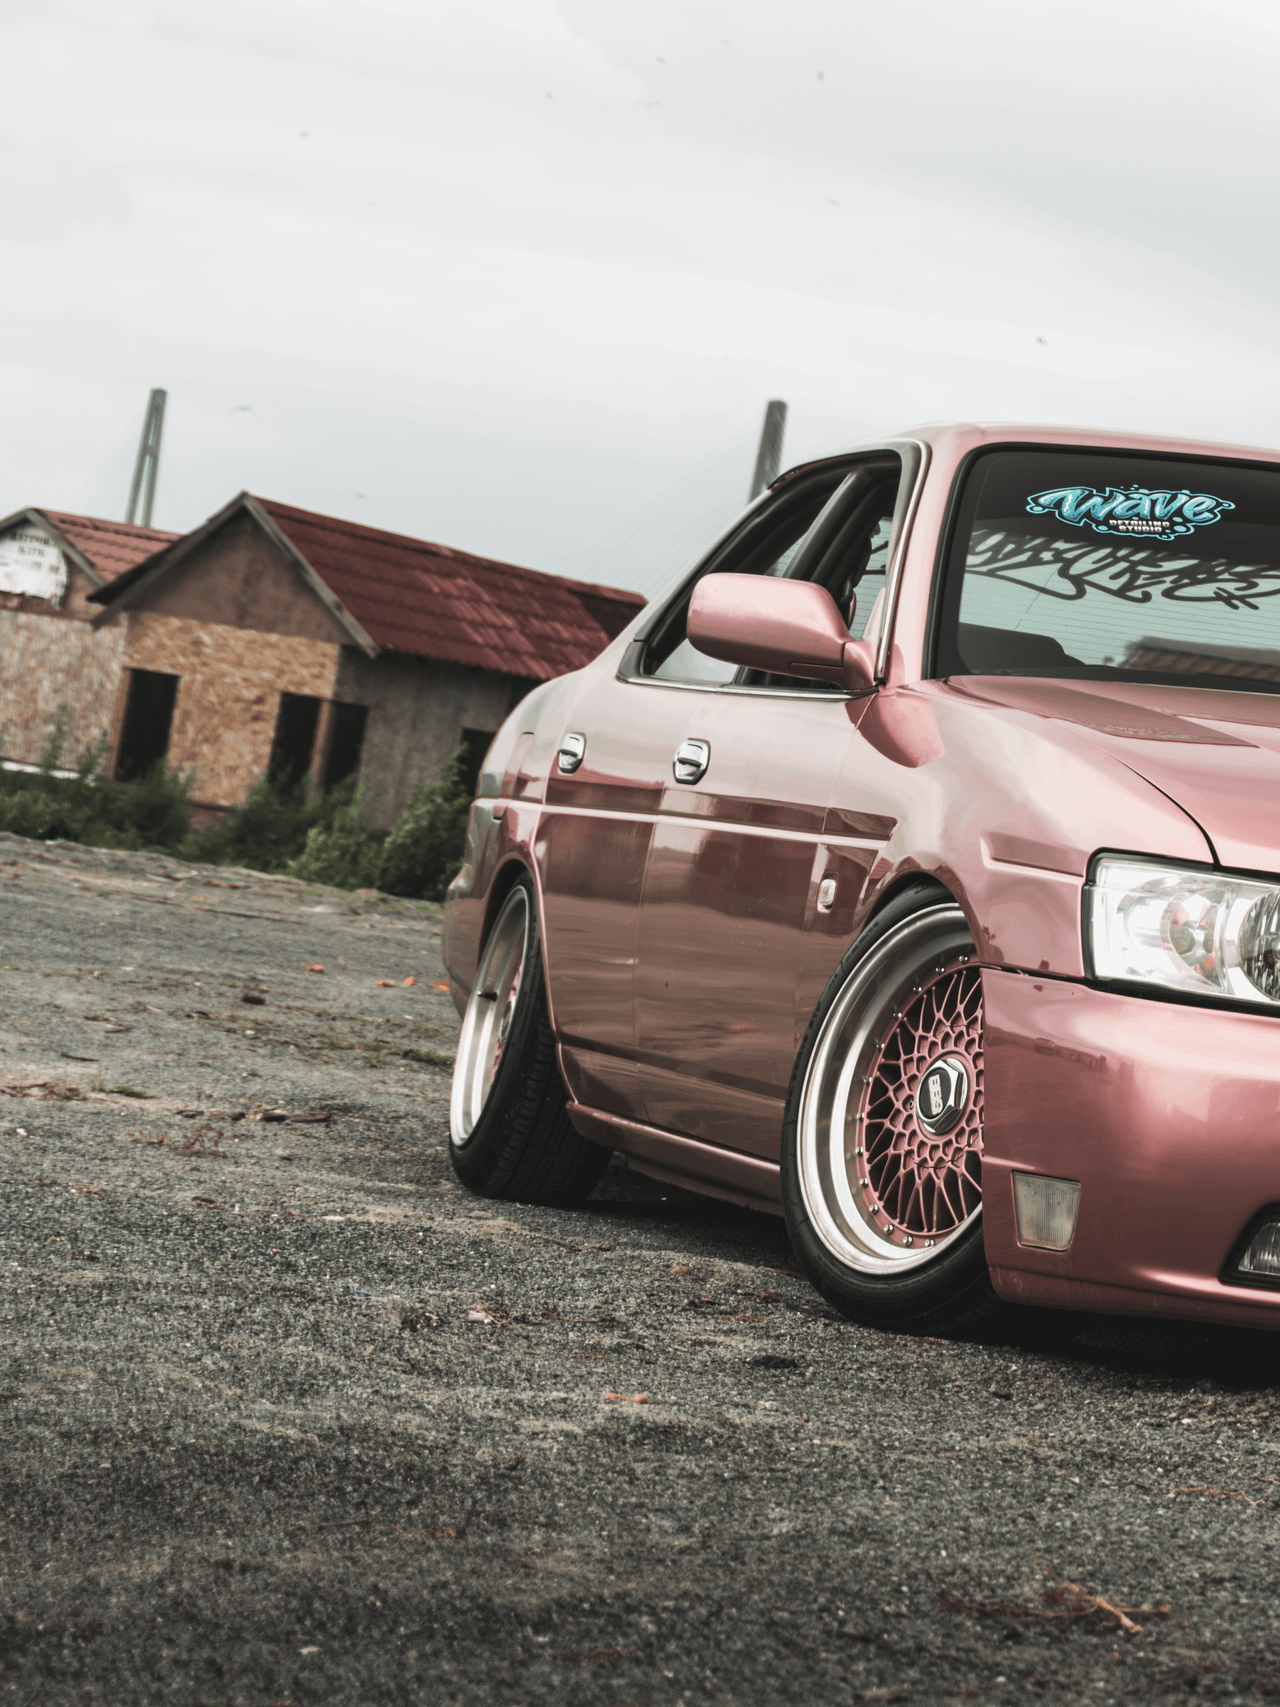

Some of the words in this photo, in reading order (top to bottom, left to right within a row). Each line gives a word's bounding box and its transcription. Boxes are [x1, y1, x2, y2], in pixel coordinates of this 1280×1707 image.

[1109, 519, 1170, 528] DETAILING
[1118, 525, 1163, 533] STUDIO
[927, 1073, 944, 1116] BBS
